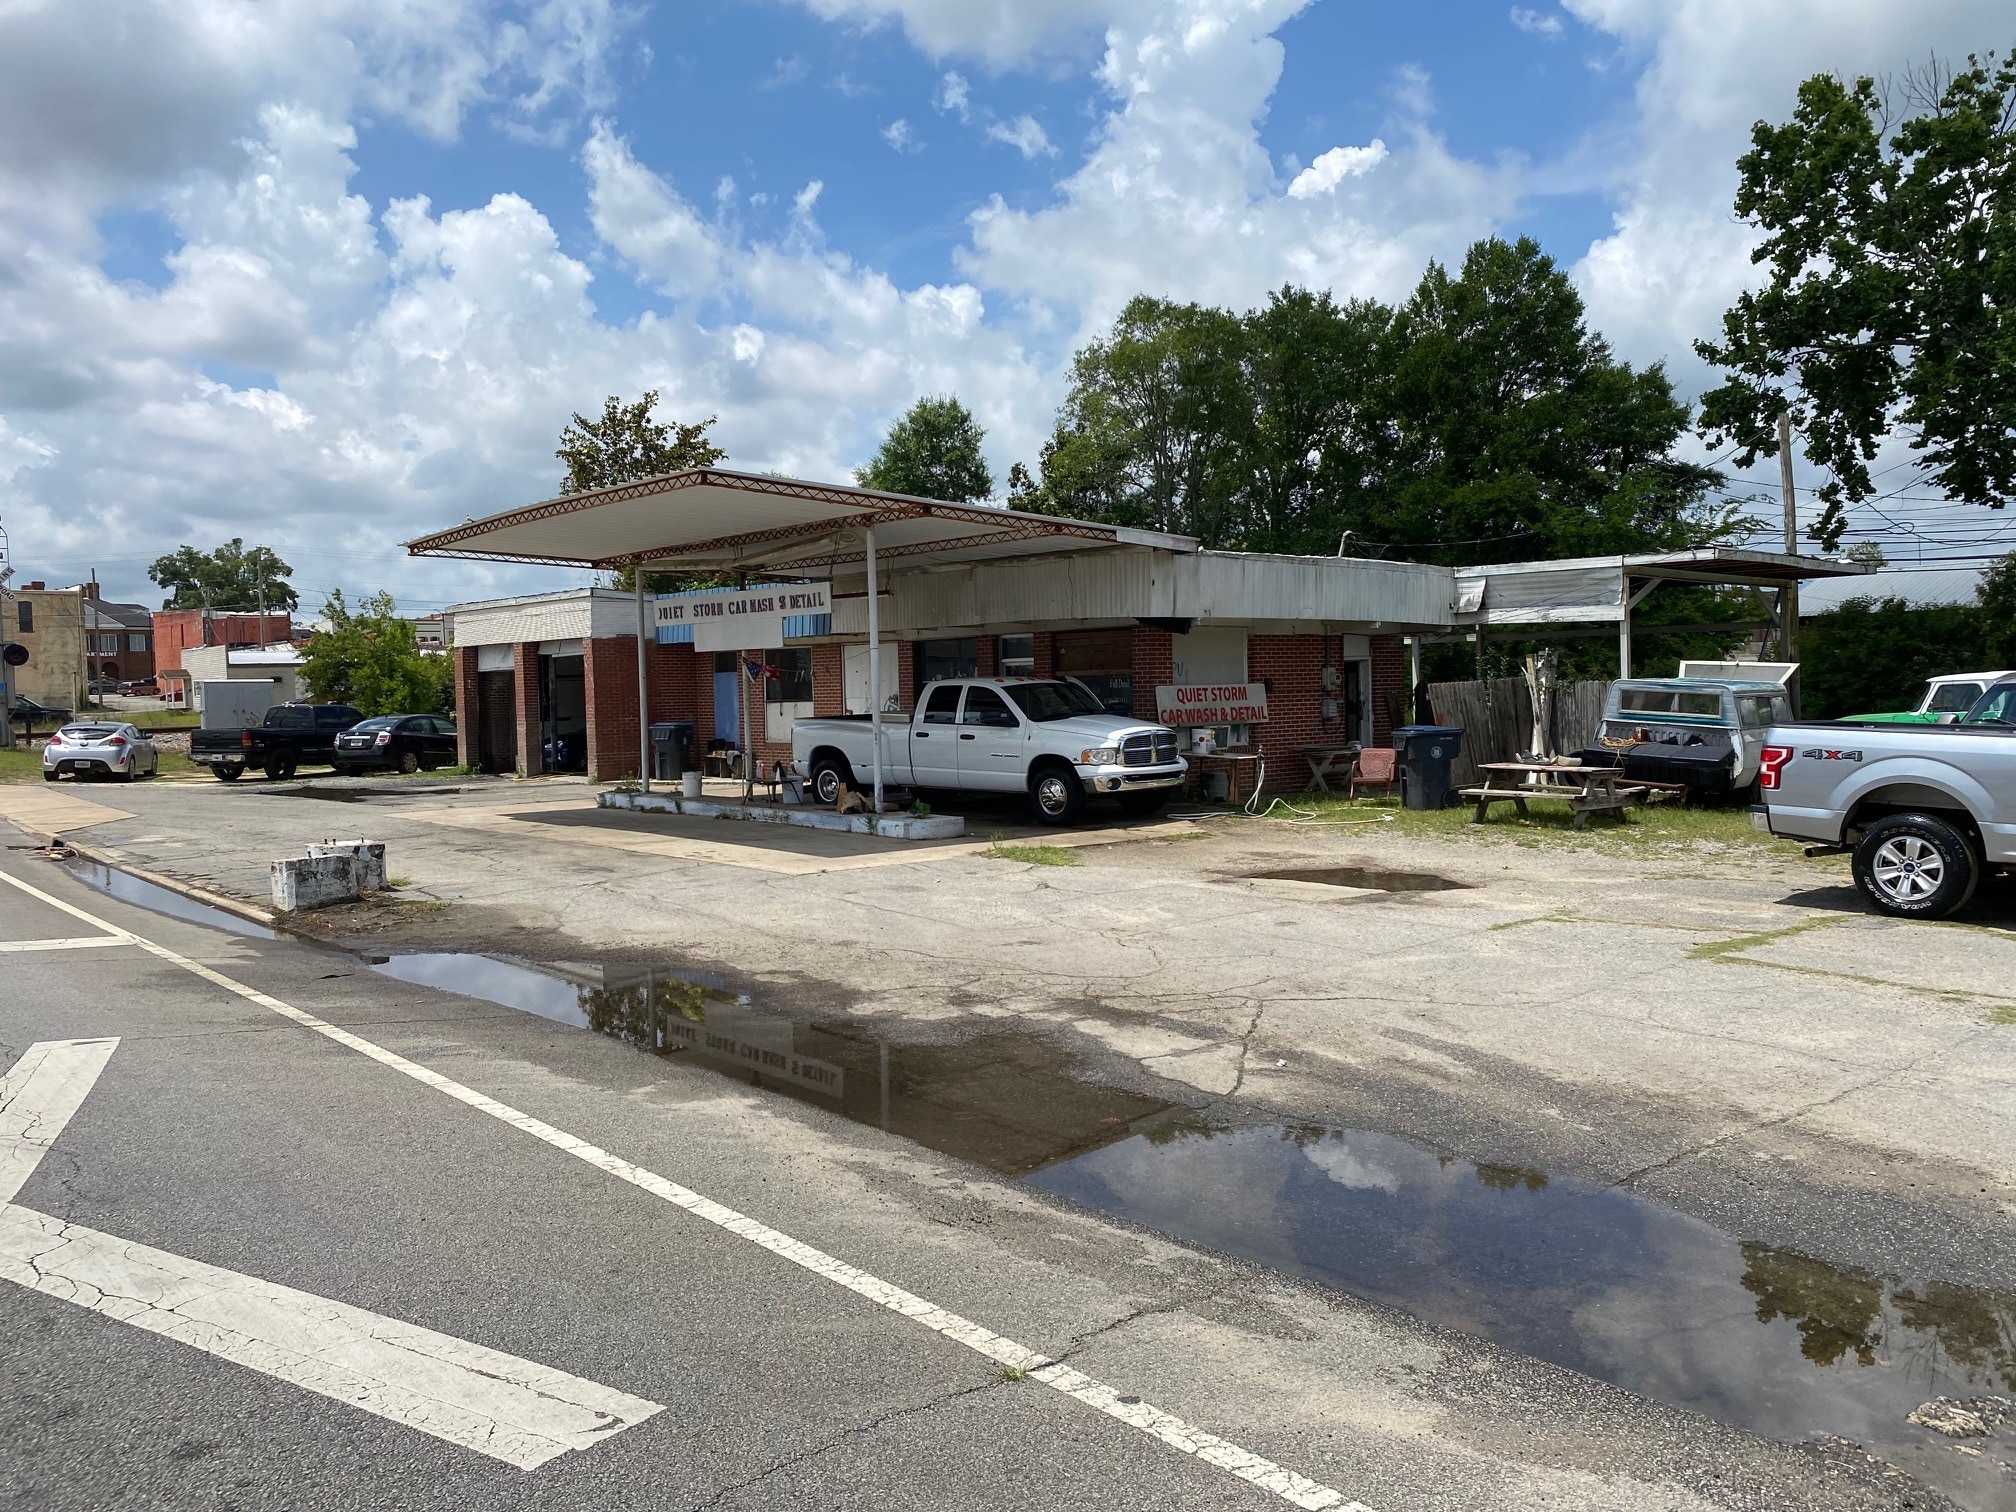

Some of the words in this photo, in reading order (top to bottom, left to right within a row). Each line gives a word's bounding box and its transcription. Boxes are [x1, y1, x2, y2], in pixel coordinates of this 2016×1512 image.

[0, 567, 14, 583] ING
[693, 602, 724, 617] STORM
[728, 599, 748, 615] CAR
[789, 591, 824, 610] DETAIL
[1176, 687, 1209, 704] QUIET
[1211, 686, 1248, 701] STORM
[1160, 709, 1184, 724] CAR
[1185, 707, 1218, 723] WASH
[1220, 707, 1228, 721] &
[1230, 705, 1268, 721] DETAIL
